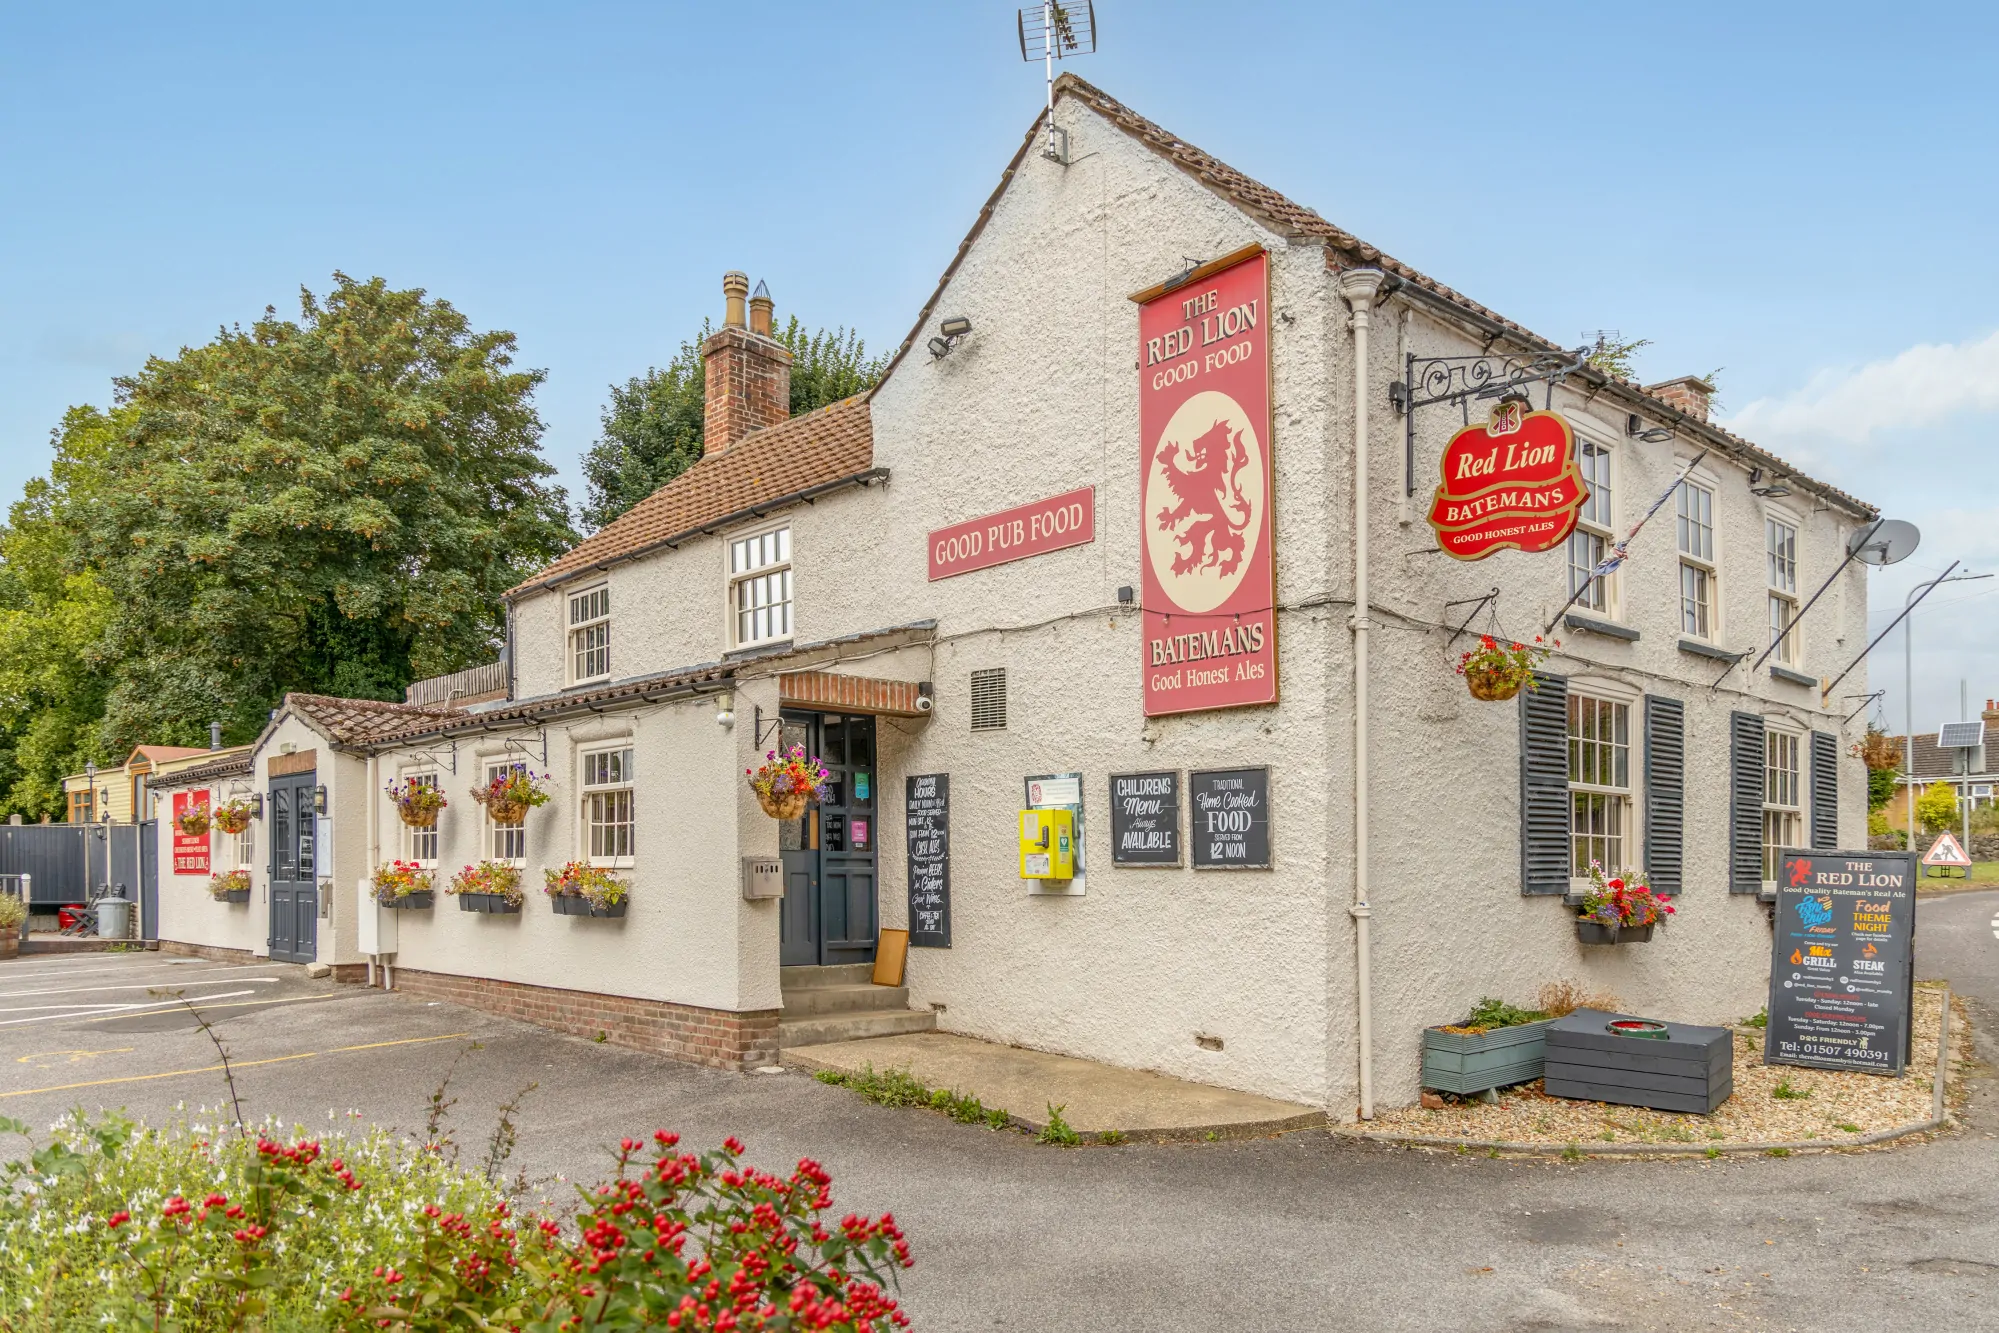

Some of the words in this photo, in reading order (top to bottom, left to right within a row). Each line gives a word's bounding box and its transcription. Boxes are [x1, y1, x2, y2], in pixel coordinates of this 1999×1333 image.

[1182, 289, 1218, 321] THE
[1147, 325, 1193, 367] RED
[1201, 299, 1258, 347] LION
[1153, 360, 1198, 391] GOOD
[1205, 341, 1252, 373] FOOD
[1455, 447, 1498, 480] Red
[1502, 441, 1556, 471] Lion
[1446, 488, 1564, 521] BATEMANS
[936, 531, 982, 565] GOOD
[988, 519, 1024, 552] PUB
[1030, 503, 1083, 541] FOOD
[1453, 532, 1483, 544] GOOD
[1484, 525, 1526, 540] HONEST
[1528, 522, 1555, 532] ALES
[1150, 622, 1265, 667] BATEMANS
[1152, 670, 1181, 691] Good
[1187, 665, 1229, 687] Honest
[1235, 660, 1265, 681] Ales
[914, 787, 936, 798] HOURS
[1117, 778, 1171, 796] CHILDRENS
[1213, 778, 1244, 790] TRADITIONAL
[1123, 798, 1164, 815] Menu
[1196, 792, 1221, 810] Home
[1223, 790, 1260, 810] Cooked
[1131, 818, 1156, 832] Always
[1207, 810, 1251, 833] FOOD
[1122, 831, 1171, 850] AVAILABLE
[1210, 843, 1224, 859] 12
[1225, 842, 1246, 858] NOON
[1845, 862, 1872, 872] THE
[1816, 872, 1852, 885] RED
[1858, 873, 1903, 887] LION
[1804, 888, 1831, 896] Quality
[1855, 900, 1891, 913] Food
[1853, 912, 1891, 922] THEME
[1854, 923, 1888, 932] NIGHT
[1809, 946, 1832, 957] Mix
[1803, 956, 1837, 968] GRILL
[1853, 960, 1885, 971] STEAK
[1820, 1036, 1858, 1046] FRIENDLY
[1780, 1041, 1800, 1052] Tel:
[1804, 1044, 1841, 1056] 01507
[1844, 1048, 1889, 1060] 490391
